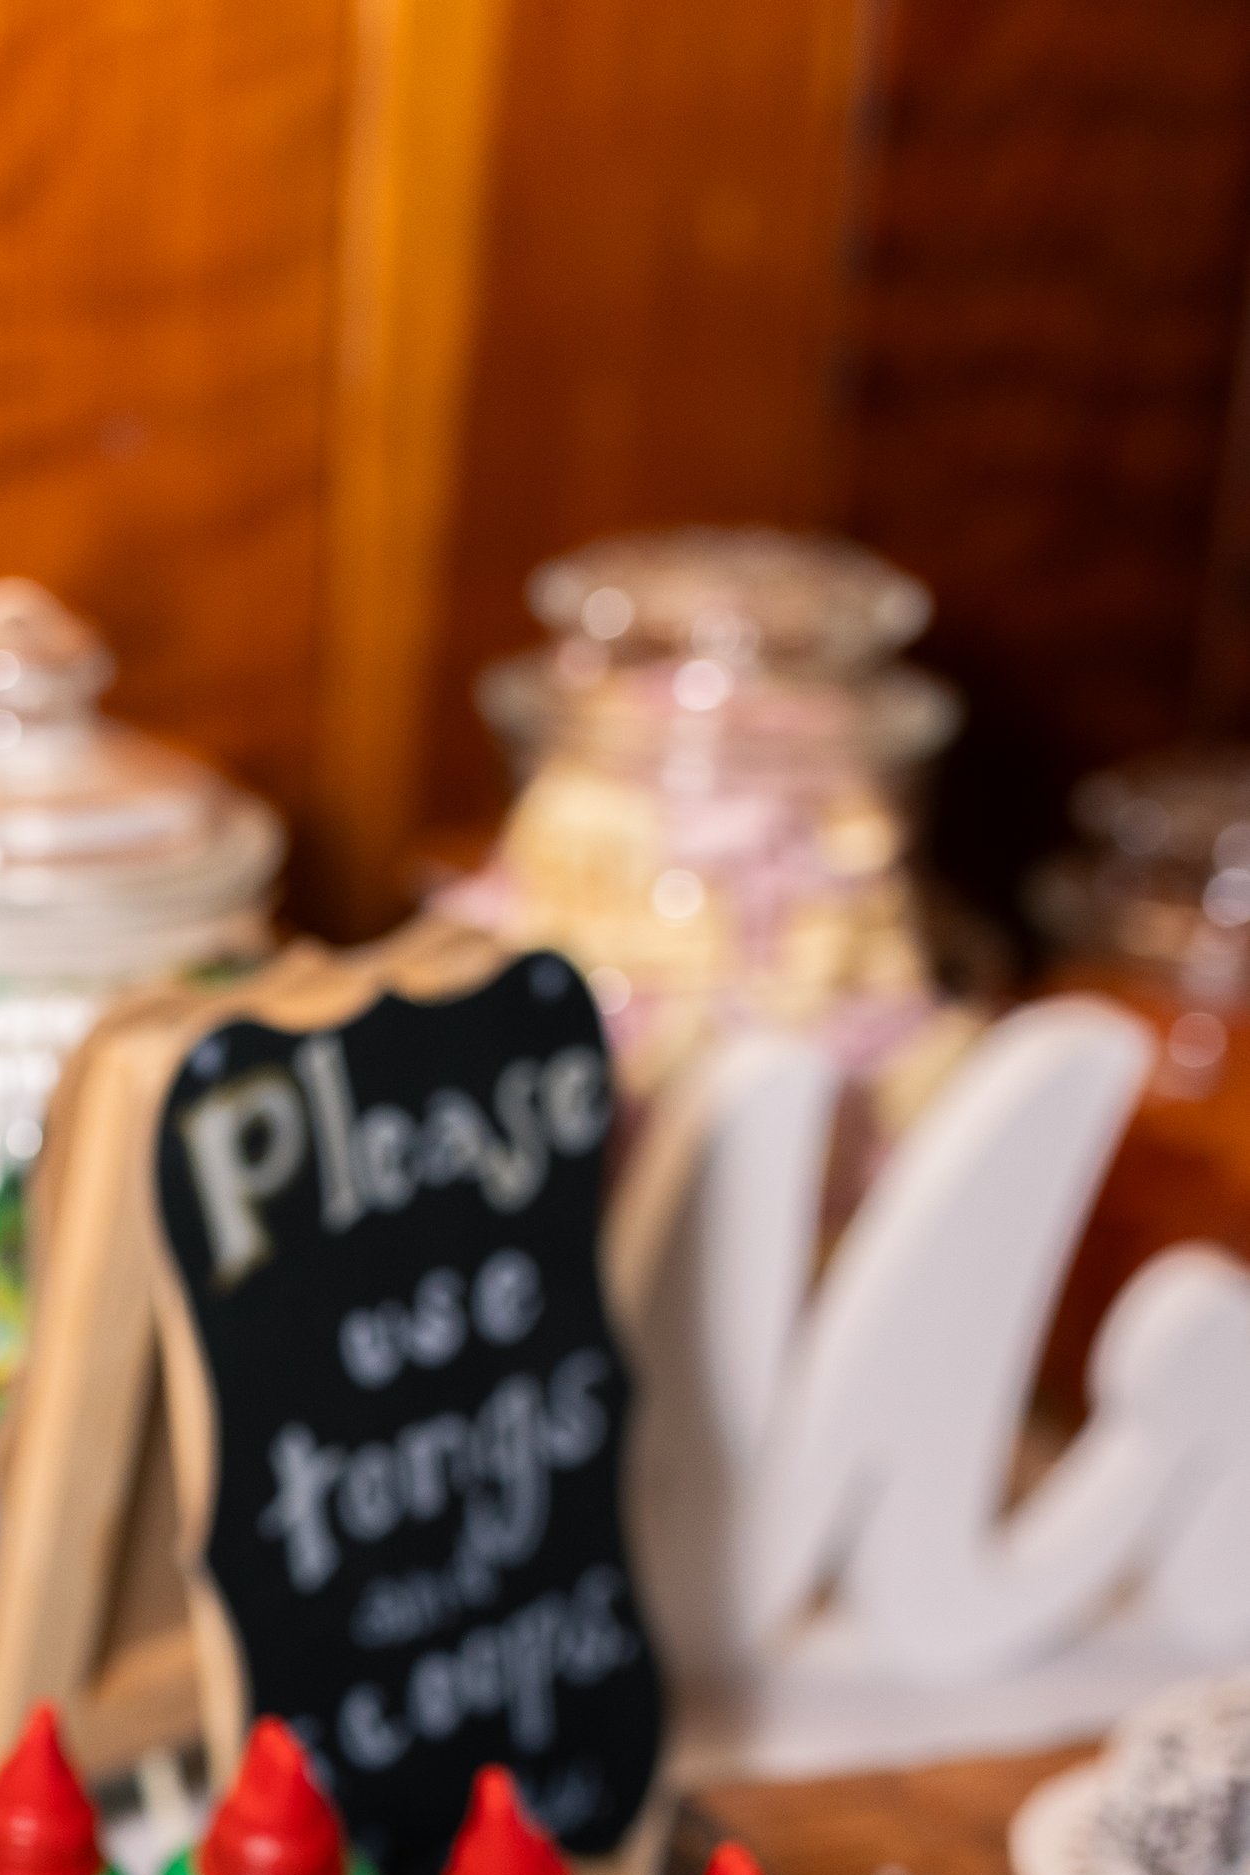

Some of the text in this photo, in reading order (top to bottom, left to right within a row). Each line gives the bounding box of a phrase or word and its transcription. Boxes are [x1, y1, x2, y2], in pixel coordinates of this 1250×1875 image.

[178, 1029, 614, 1287] Please
[338, 1248, 545, 1388] use
[259, 1347, 610, 1593] tongs
